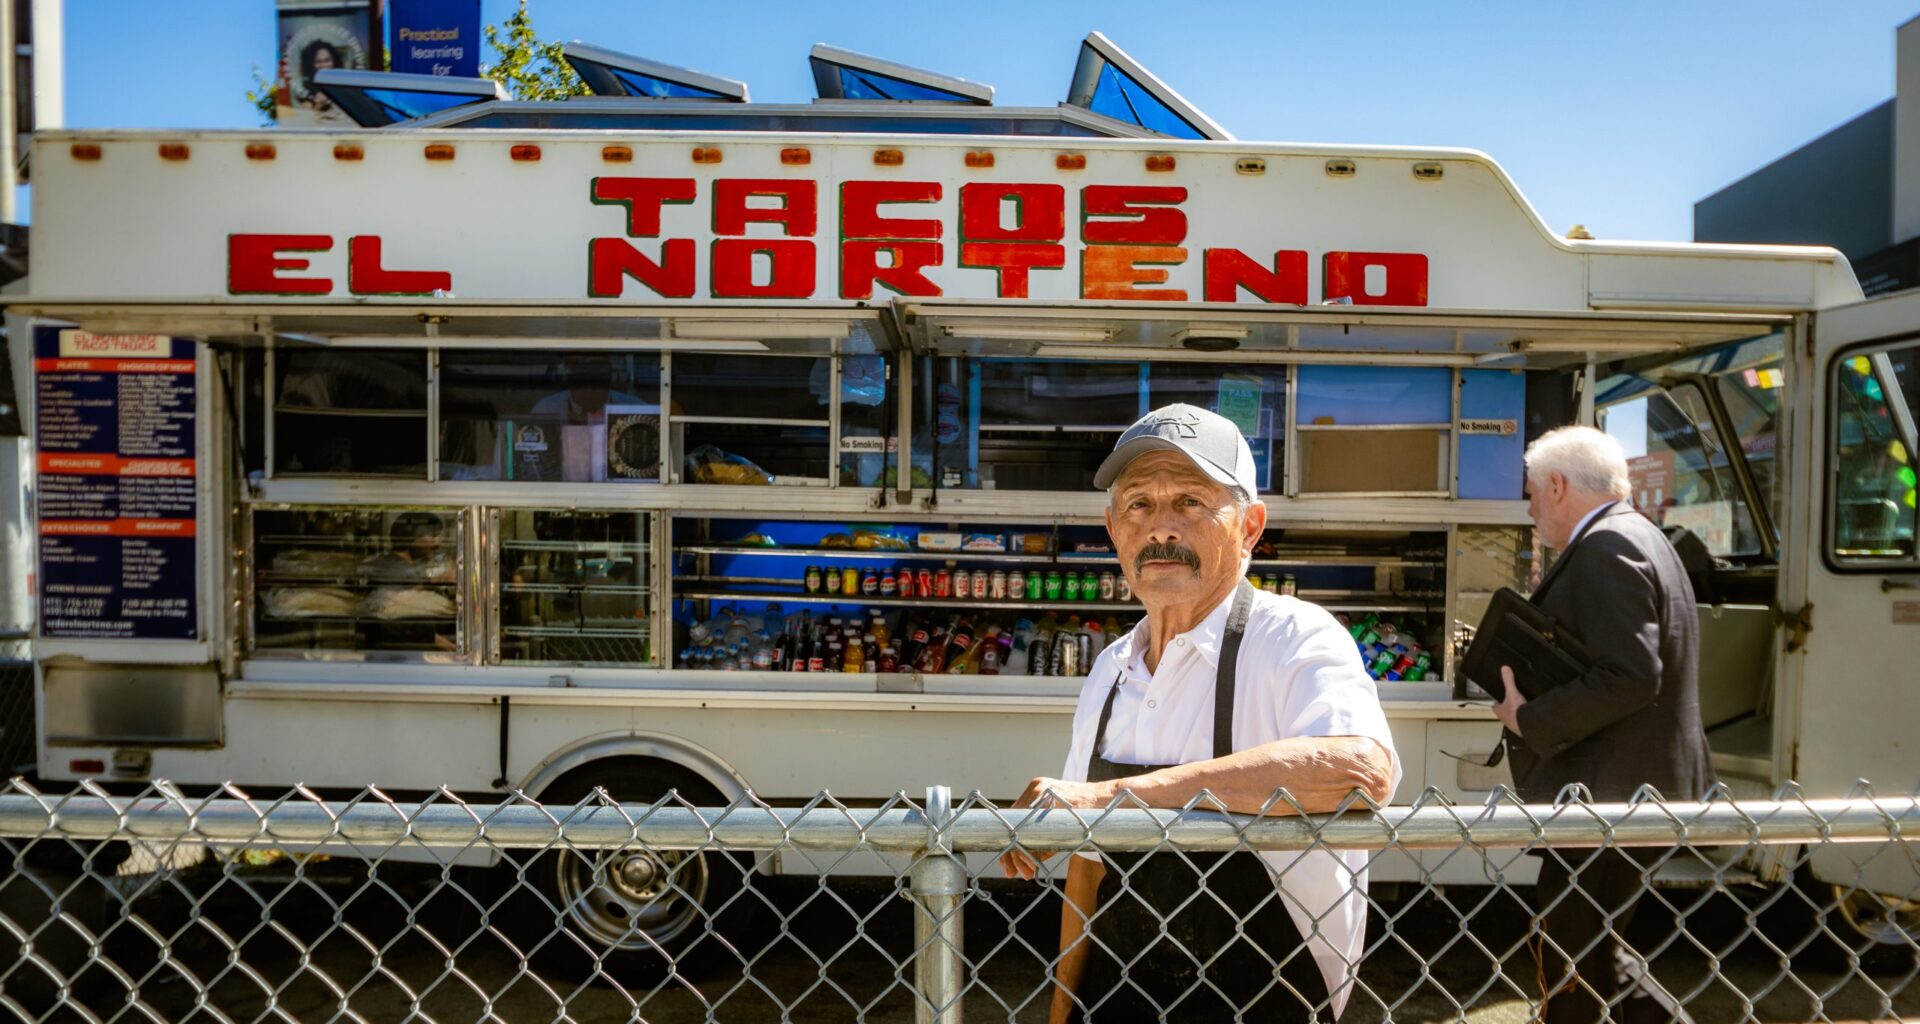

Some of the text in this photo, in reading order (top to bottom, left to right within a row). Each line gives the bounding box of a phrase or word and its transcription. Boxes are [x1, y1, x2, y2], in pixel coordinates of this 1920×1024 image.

[399, 28, 459, 41] Practical
[412, 46, 463, 60] learning
[432, 63, 452, 75] for
[591, 176, 1189, 246] TACOS
[227, 234, 1430, 306] EL NORTENO
[75, 342, 156, 351] TACO TRUCK
[1461, 422, 1501, 432] No Smoking
[840, 440, 883, 450] No Smoking
[121, 609, 188, 619] Monday to Friday
